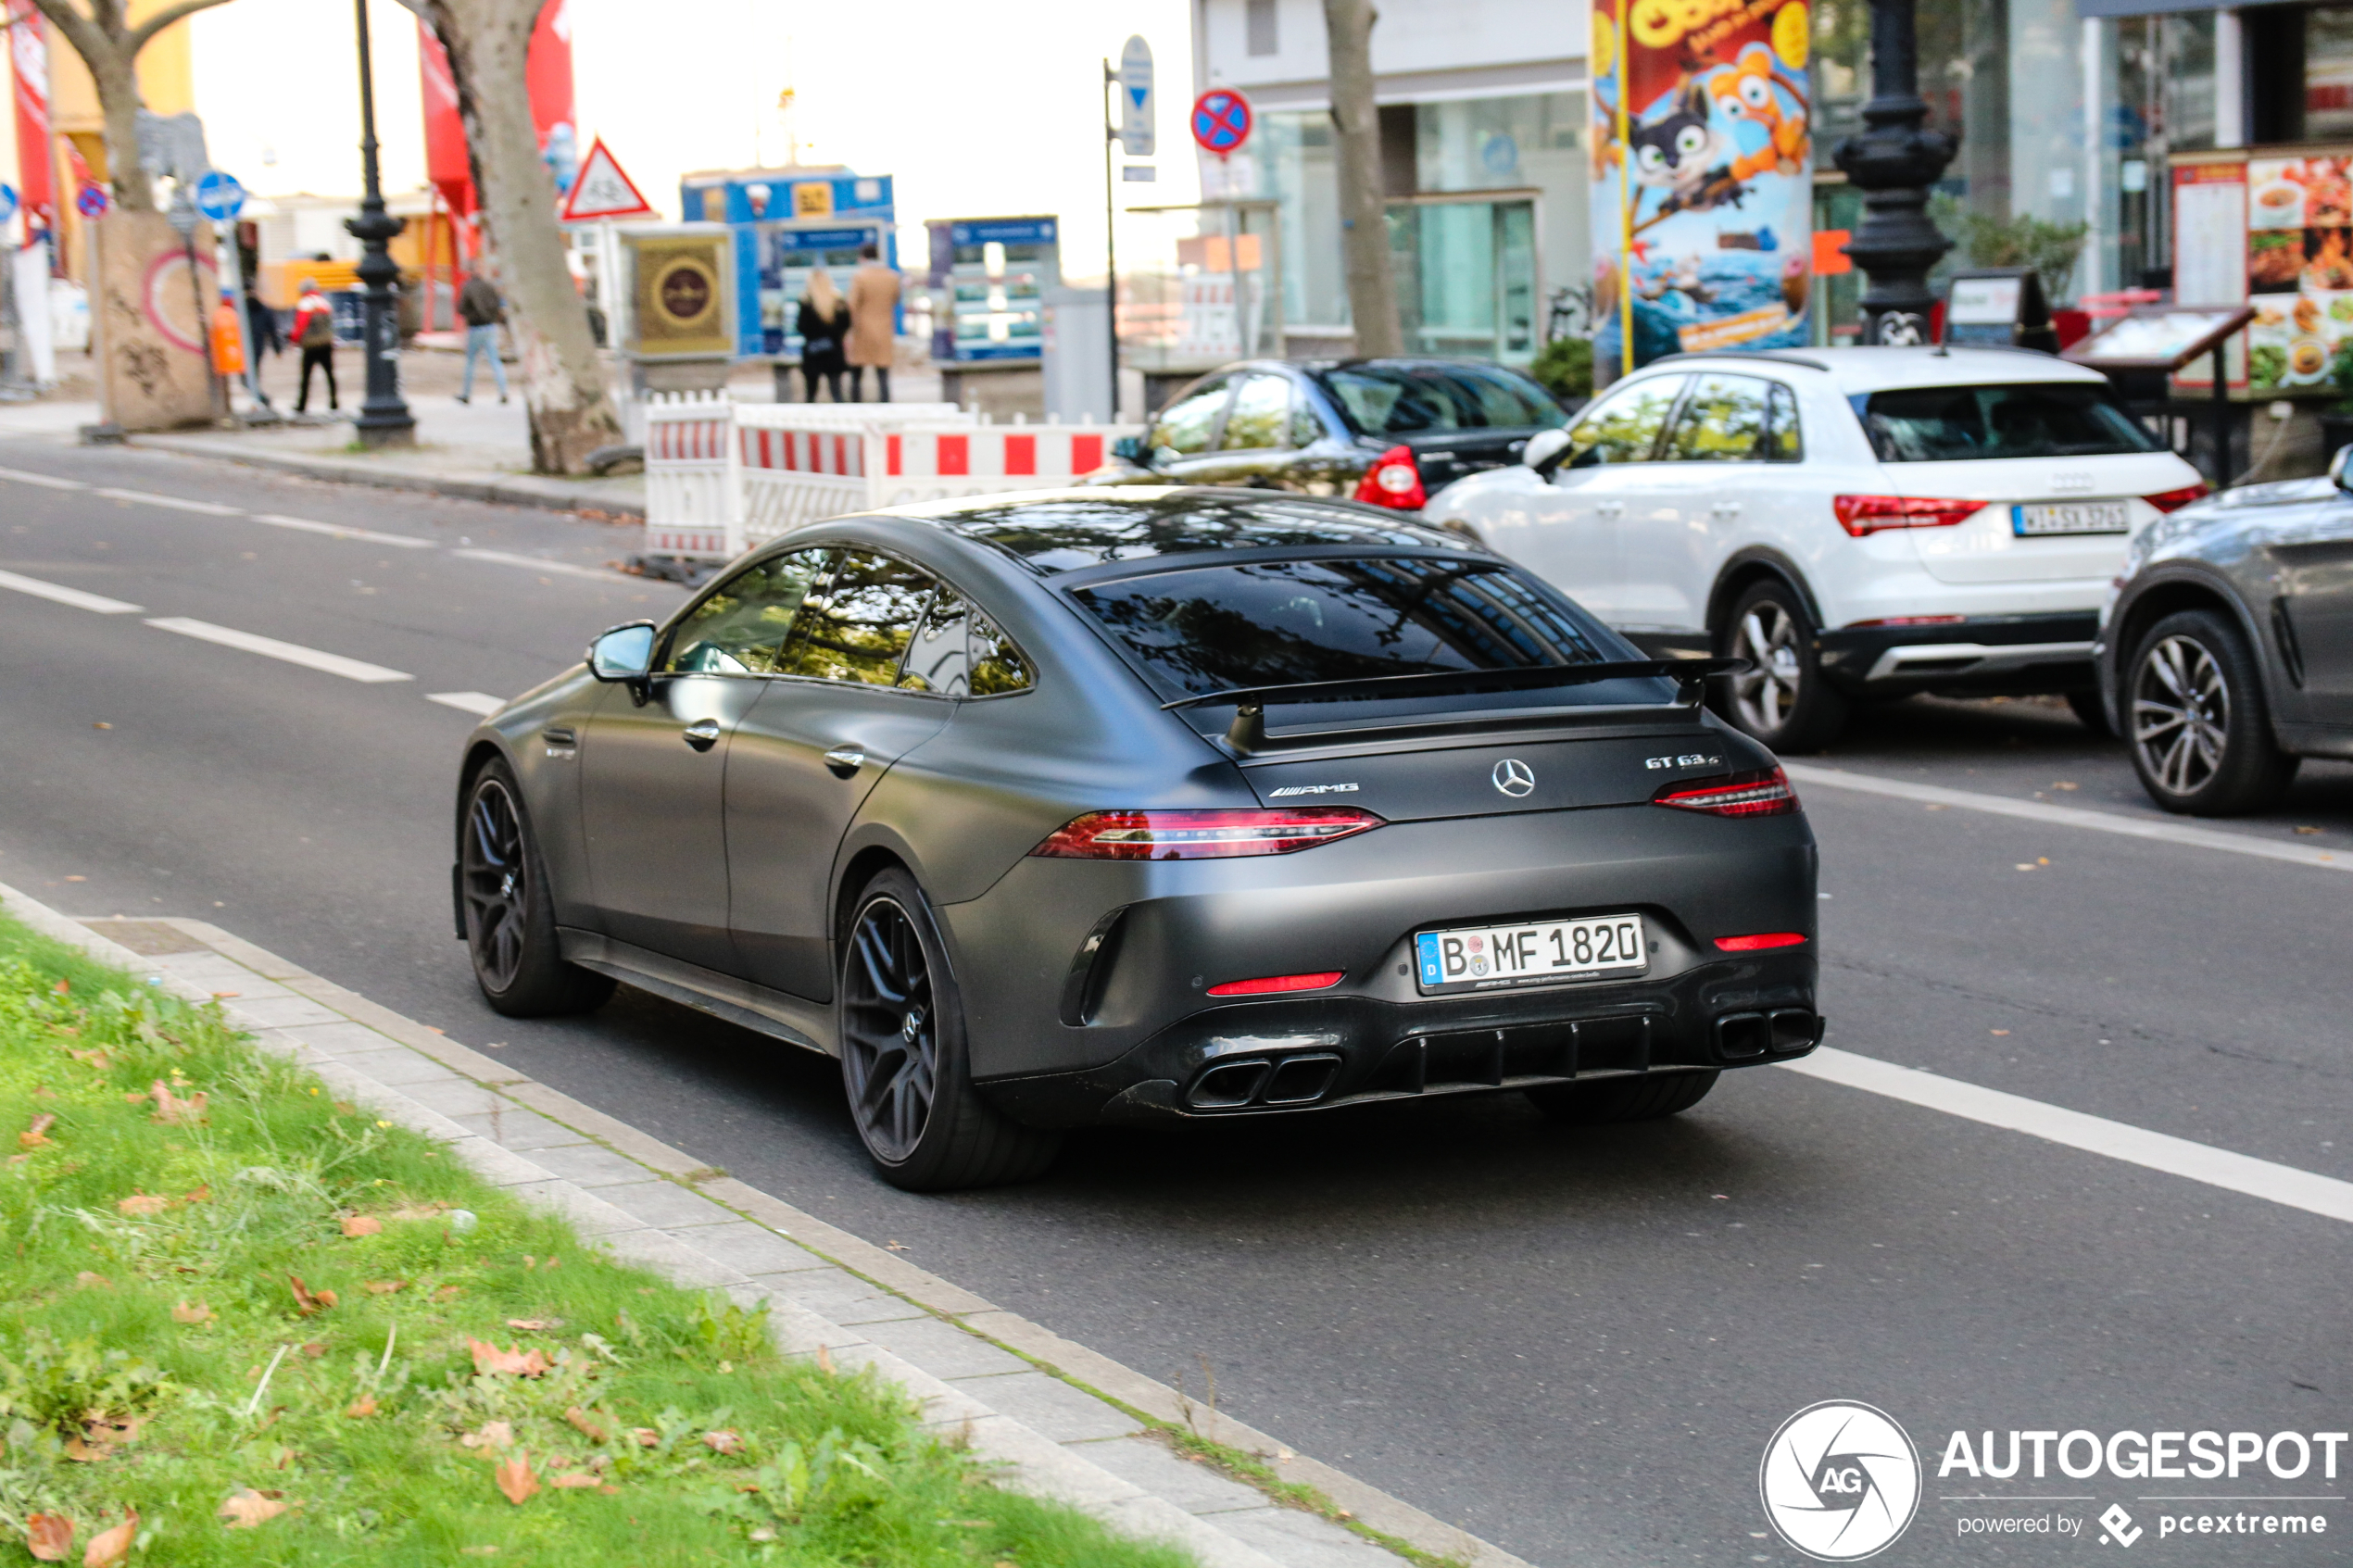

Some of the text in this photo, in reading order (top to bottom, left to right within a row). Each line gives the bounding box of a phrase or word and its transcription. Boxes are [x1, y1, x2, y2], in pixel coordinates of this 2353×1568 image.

[1645, 756, 1673, 770] GT
[1677, 753, 1705, 767] 63
[1427, 922, 1639, 976] D B MF 1820
